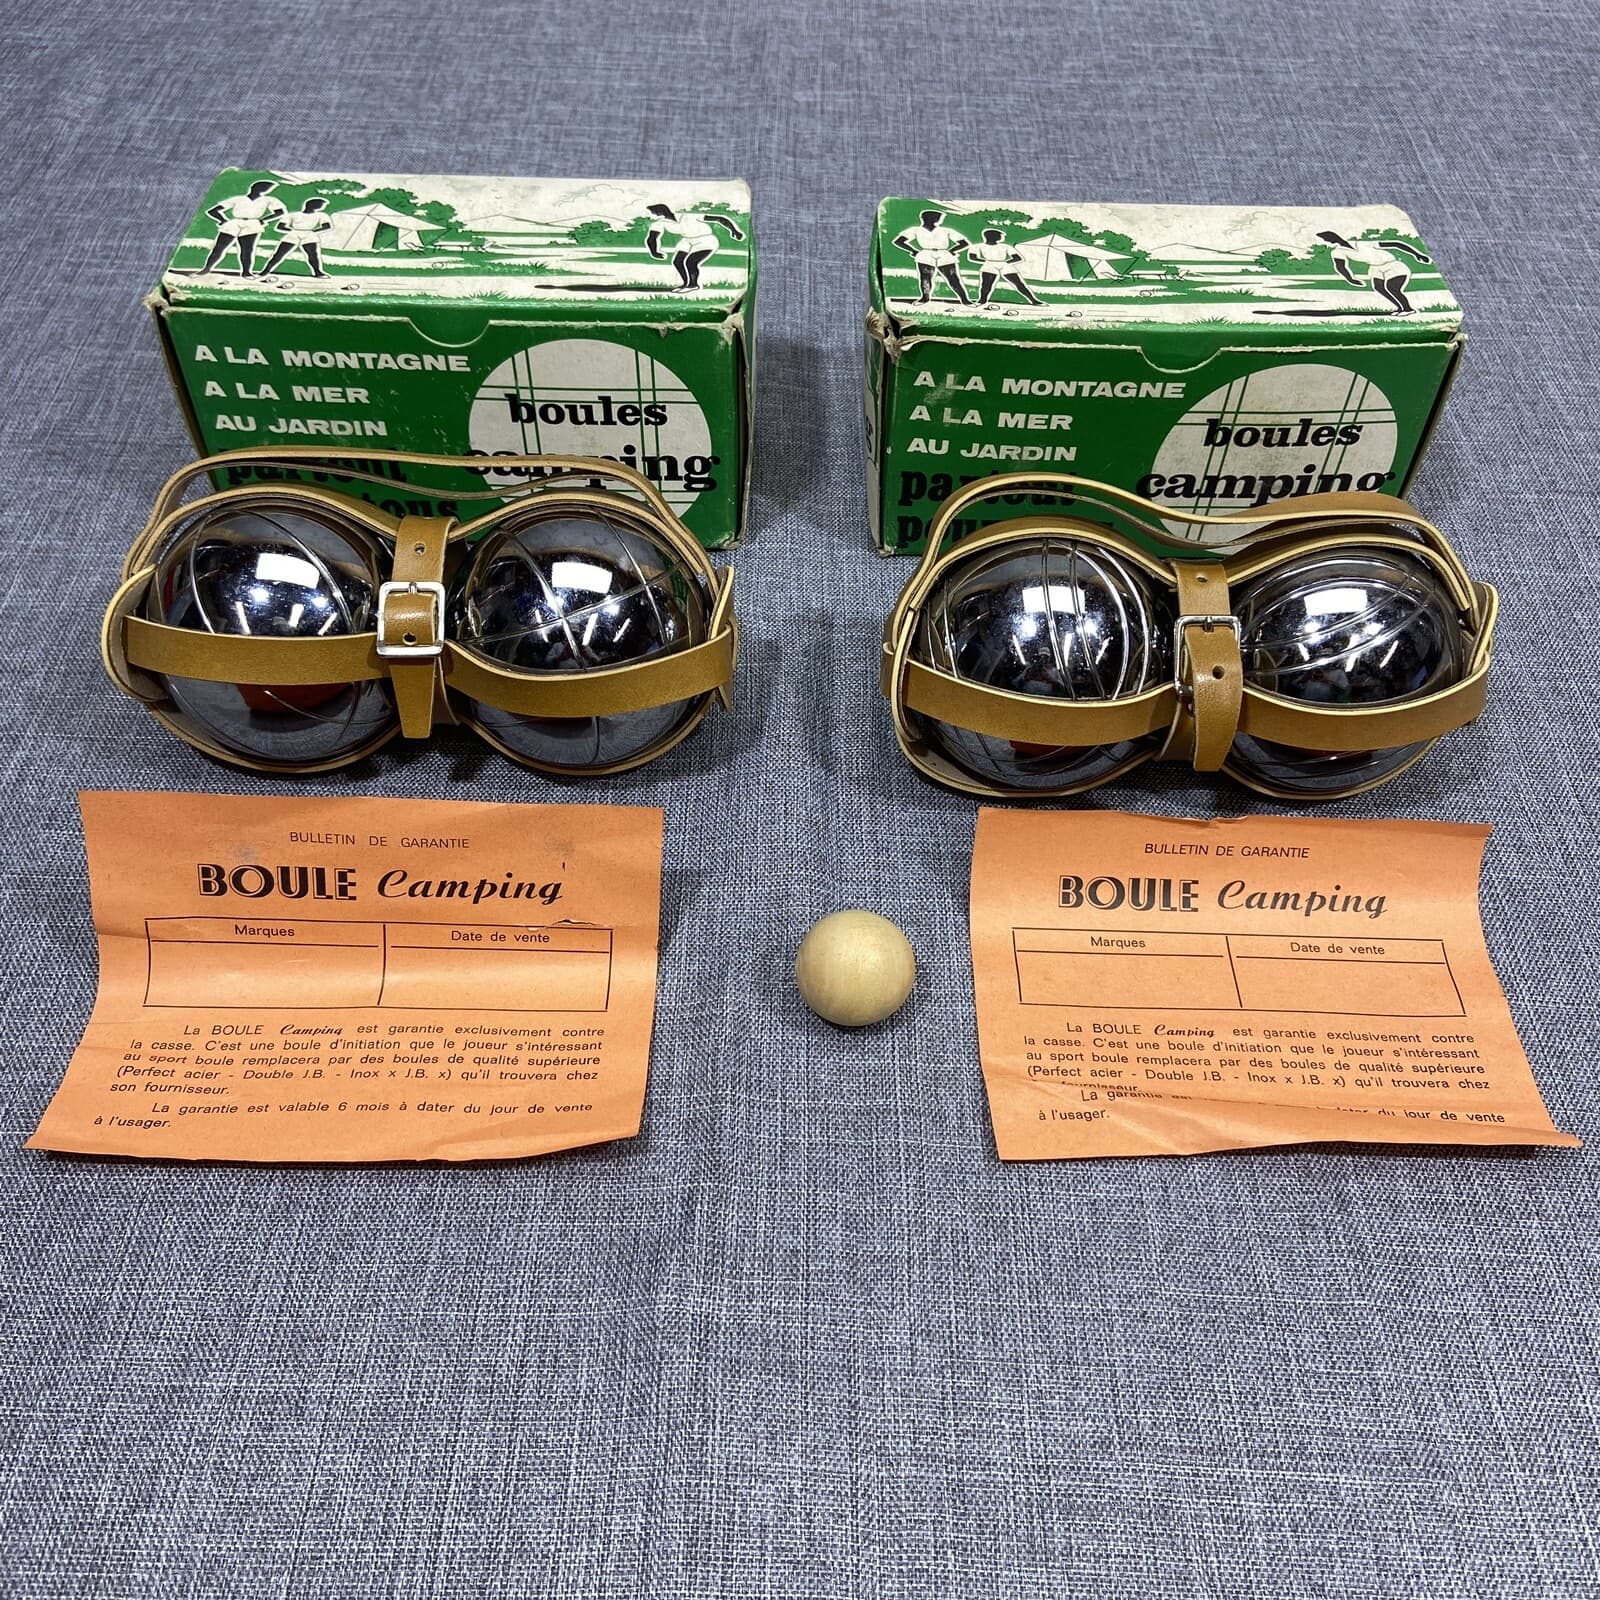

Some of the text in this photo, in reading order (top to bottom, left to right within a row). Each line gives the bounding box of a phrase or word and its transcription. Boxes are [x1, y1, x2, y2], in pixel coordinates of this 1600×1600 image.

[194, 345, 471, 372] A LA MONTAGNE
[204, 381, 370, 403] A LA MER
[913, 371, 1186, 398] A LA MONTAGNE
[504, 393, 667, 425] boules
[909, 405, 1073, 429] A LA MER
[215, 414, 387, 436] AU JARDIN
[1203, 418, 1363, 447] boules
[907, 438, 1077, 462] AU JARDIN
[361, 493, 457, 517] ous
[290, 832, 469, 848] BULLETIN DE GARANTIE
[1144, 844, 1309, 858] BULLETIN DE GARANTIE
[197, 864, 564, 905] BOULE Camping
[1058, 874, 1387, 919] BOULE Camping
[235, 924, 295, 938] Marques
[451, 930, 550, 943] Date de vente
[1090, 936, 1145, 949] Marques
[1290, 941, 1385, 955] Date de vente
[184, 1024, 605, 1037] La BOULE Camping est garantie exclusivement contre
[1067, 1022, 1474, 1043] La BOULE Camping est garantie exclusivement contre
[130, 1038, 602, 1052] la casse. C'est une boule d'initiation que le joueur s'intéressant
[1024, 1036, 1480, 1058] la casse. C'est une boule d'initiation que le joueur s'intéressant
[124, 1053, 600, 1068] au sport boule remplacera par des boules de qualité supérieure
[1027, 1052, 1485, 1076] au sport boule remplacera par des boules de qualité supérieure
[117, 1065, 176, 1078] (Perfect
[184, 1069, 221, 1080] acier
[243, 1069, 293, 1080] Double
[350, 1069, 380, 1080] Inox
[387, 1070, 396, 1079] x
[437, 1069, 451, 1080] x)
[461, 1068, 491, 1081] qu'il
[500, 1069, 558, 1080] trouvera
[566, 1069, 598, 1080] chez
[1028, 1065, 1082, 1077] (Perfect
[1090, 1067, 1123, 1078] acier
[1145, 1069, 1194, 1081] Double
[1248, 1072, 1277, 1083] Inox
[1284, 1075, 1293, 1084] x
[1333, 1075, 1346, 1088] x)
[1355, 1077, 1384, 1089] qu'il
[1391, 1078, 1450, 1089] trouvera
[1458, 1079, 1490, 1089] chez
[110, 1082, 229, 1095] son fournisseur.
[152, 1101, 592, 1116] La garantie est valable 6 mois à dater du jour de vente
[1038, 1108, 1110, 1122] à l'usager.
[1081, 1089, 1098, 1101] La
[1440, 1109, 1458, 1120] de
[1466, 1113, 1505, 1123] vente
[94, 1115, 171, 1129] à l'usager.
